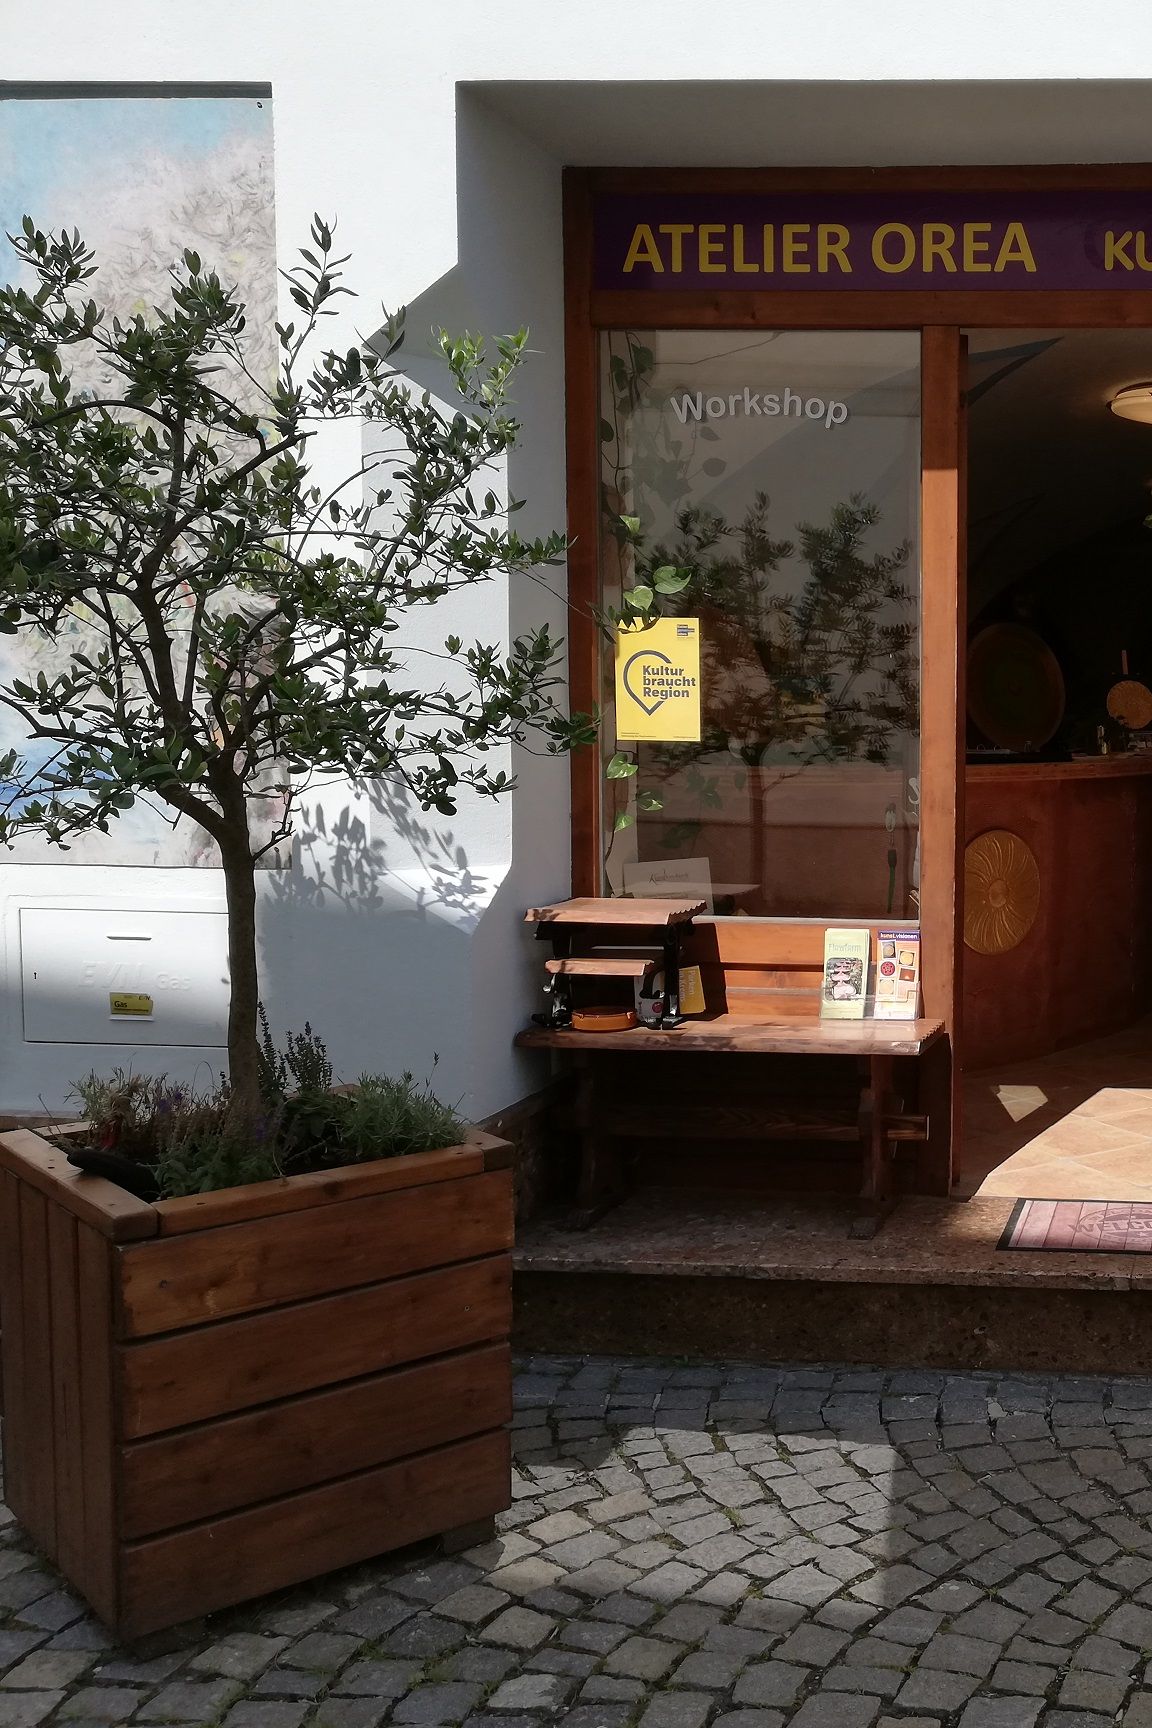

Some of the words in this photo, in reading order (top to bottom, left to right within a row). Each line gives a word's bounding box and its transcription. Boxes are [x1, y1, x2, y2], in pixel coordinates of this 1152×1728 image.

[622, 223, 853, 273] ATELIER
[871, 222, 1037, 274] OREA
[670, 387, 848, 429] Workshop
[642, 665, 684, 676] Kultur
[643, 676, 696, 687] braucht
[643, 687, 690, 699] Region
[114, 1000, 128, 1008] Gas
